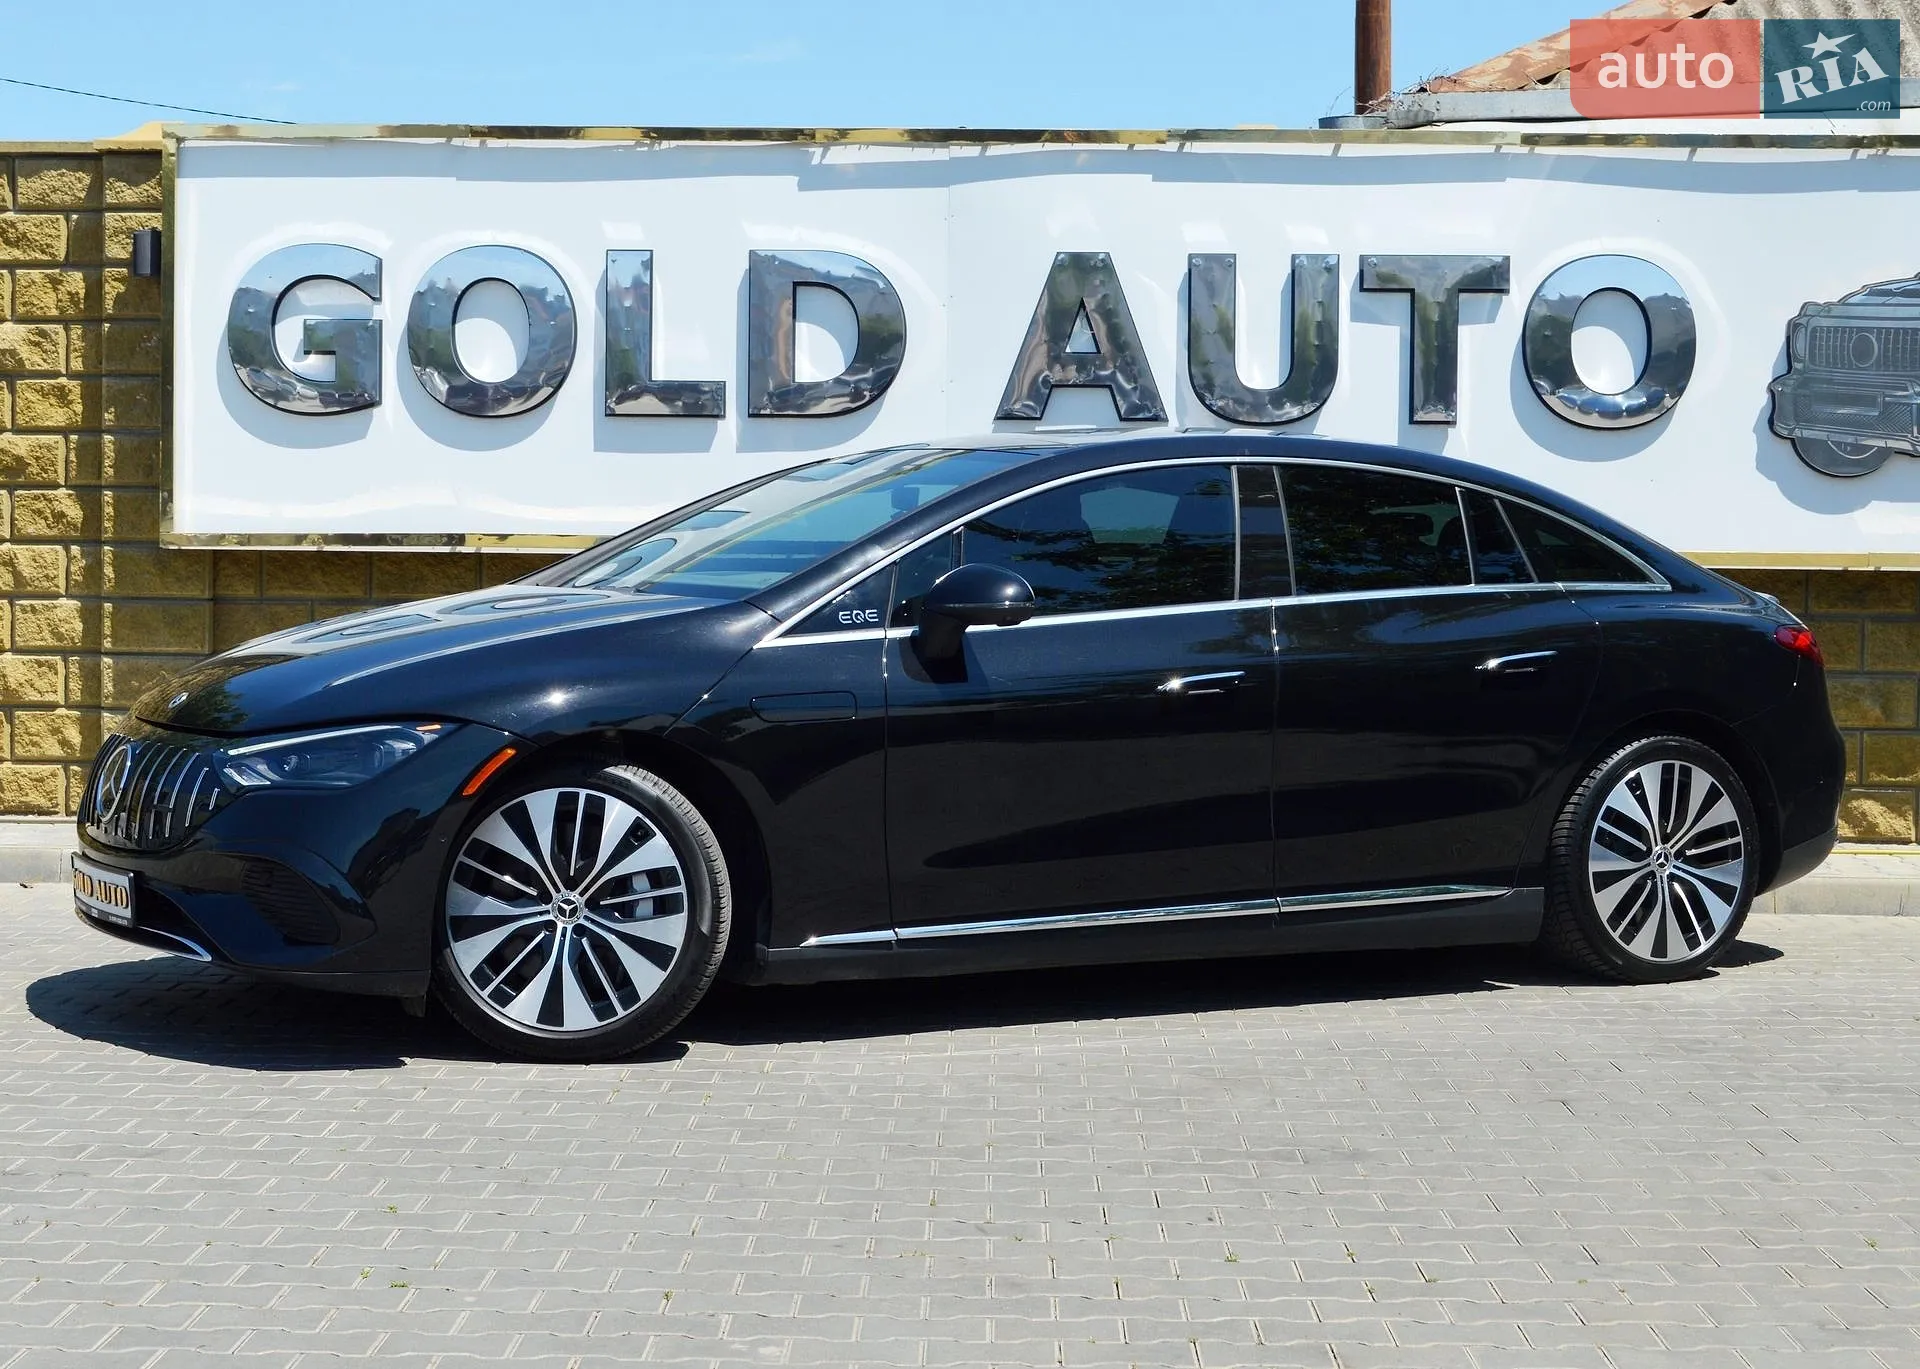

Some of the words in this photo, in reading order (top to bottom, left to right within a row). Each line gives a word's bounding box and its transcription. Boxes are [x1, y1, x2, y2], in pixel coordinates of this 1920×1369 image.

[227, 242, 908, 419] GOLD
[992, 251, 1698, 431] AUTO
[838, 609, 879, 624] EQE
[96, 879, 129, 910] AUTO
